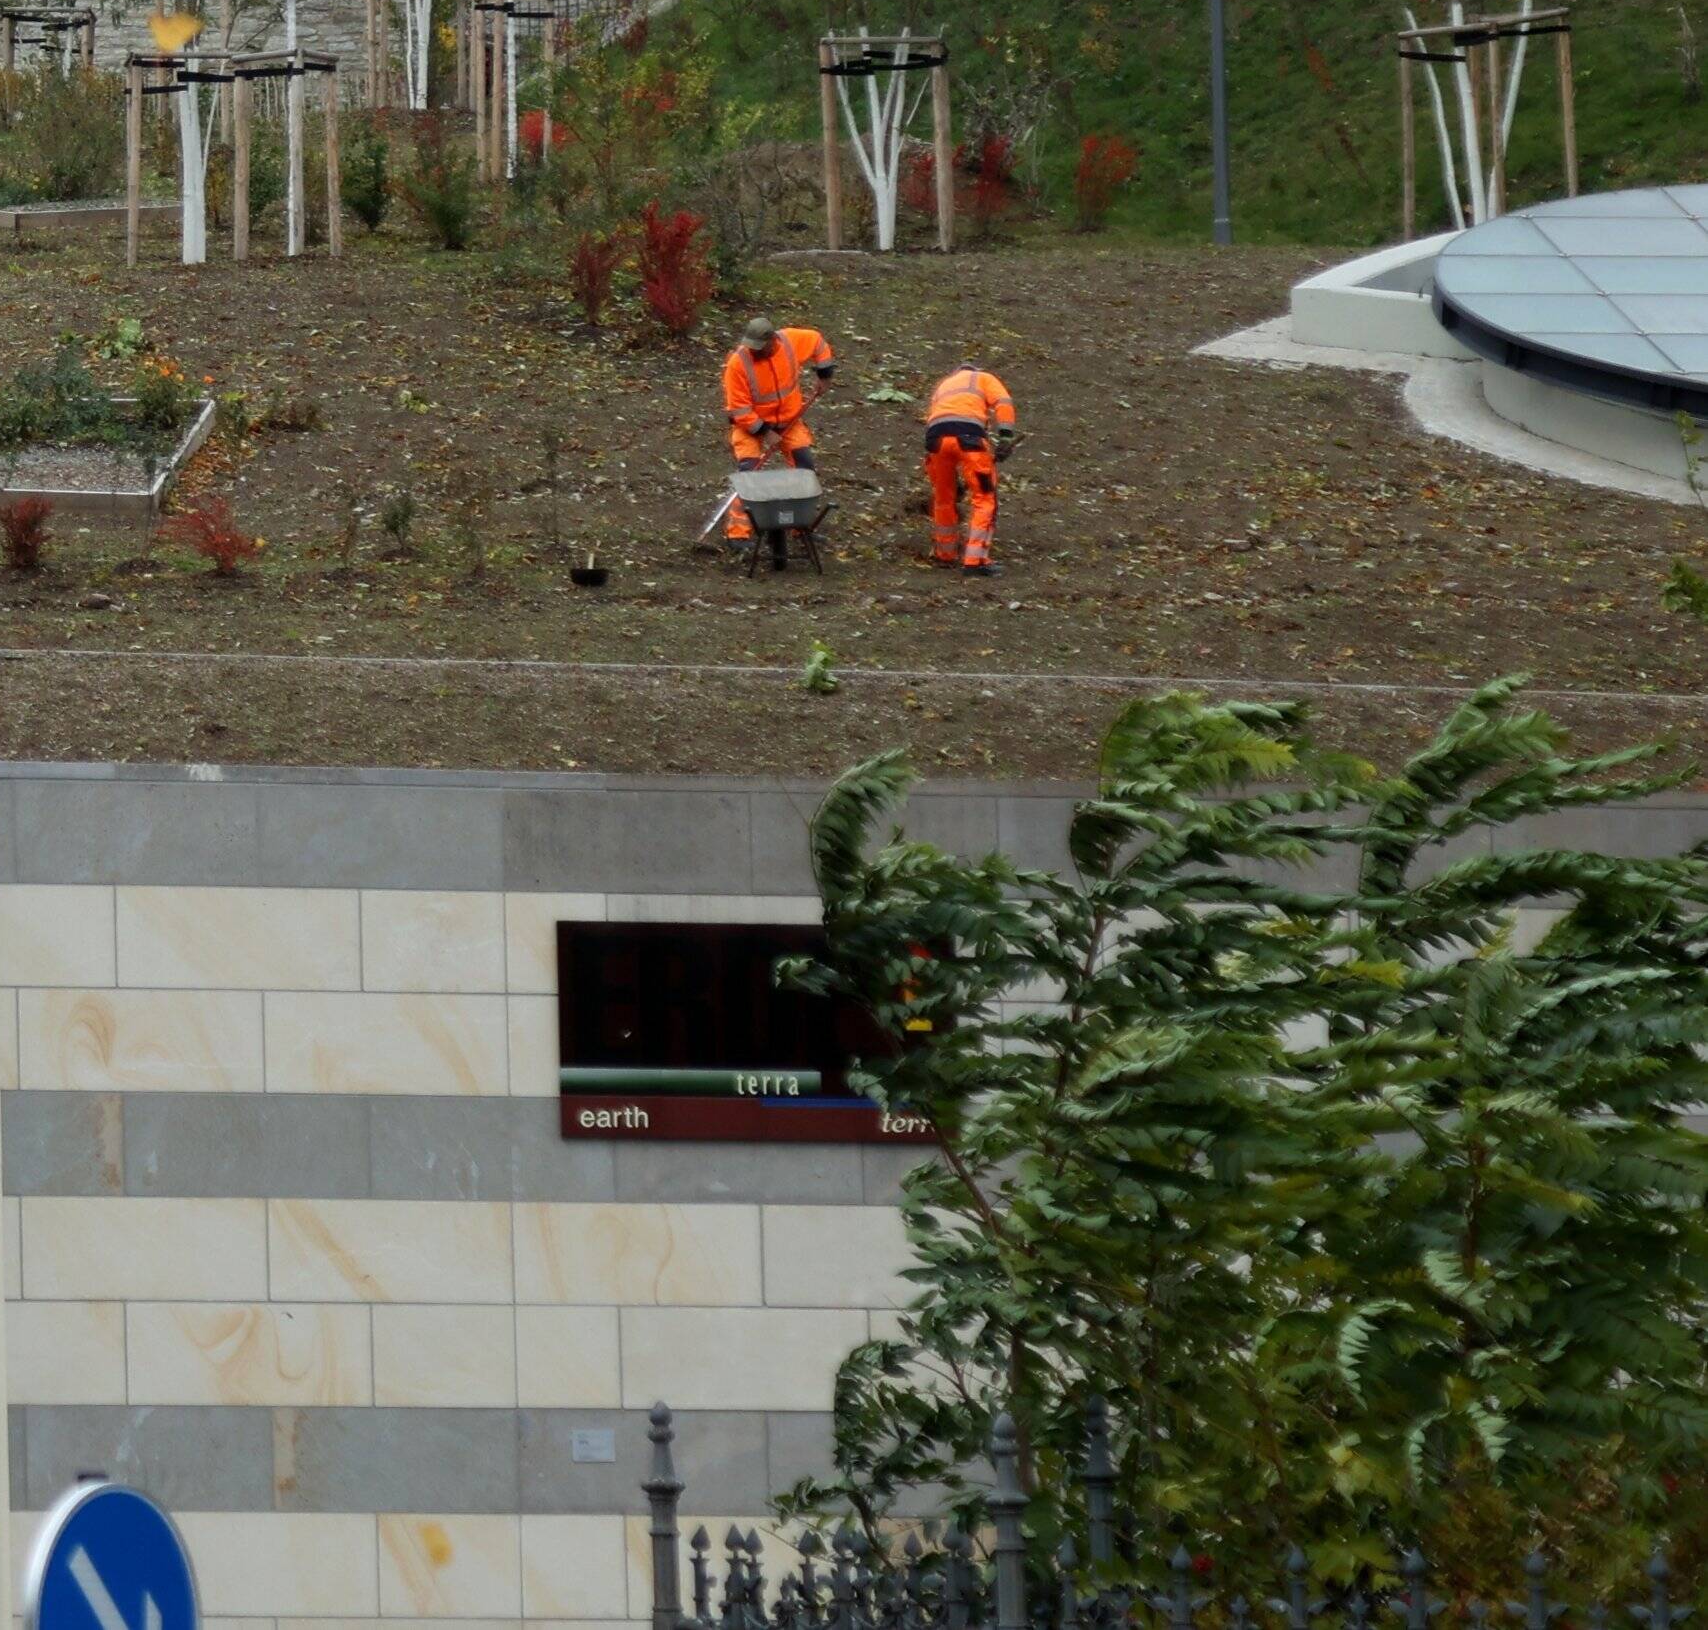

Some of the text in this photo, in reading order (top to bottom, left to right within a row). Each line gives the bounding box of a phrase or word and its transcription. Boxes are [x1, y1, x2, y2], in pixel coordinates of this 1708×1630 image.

[736, 1073, 800, 1096] terra
[580, 1106, 649, 1128] earth
[882, 1112, 936, 1133] terr
